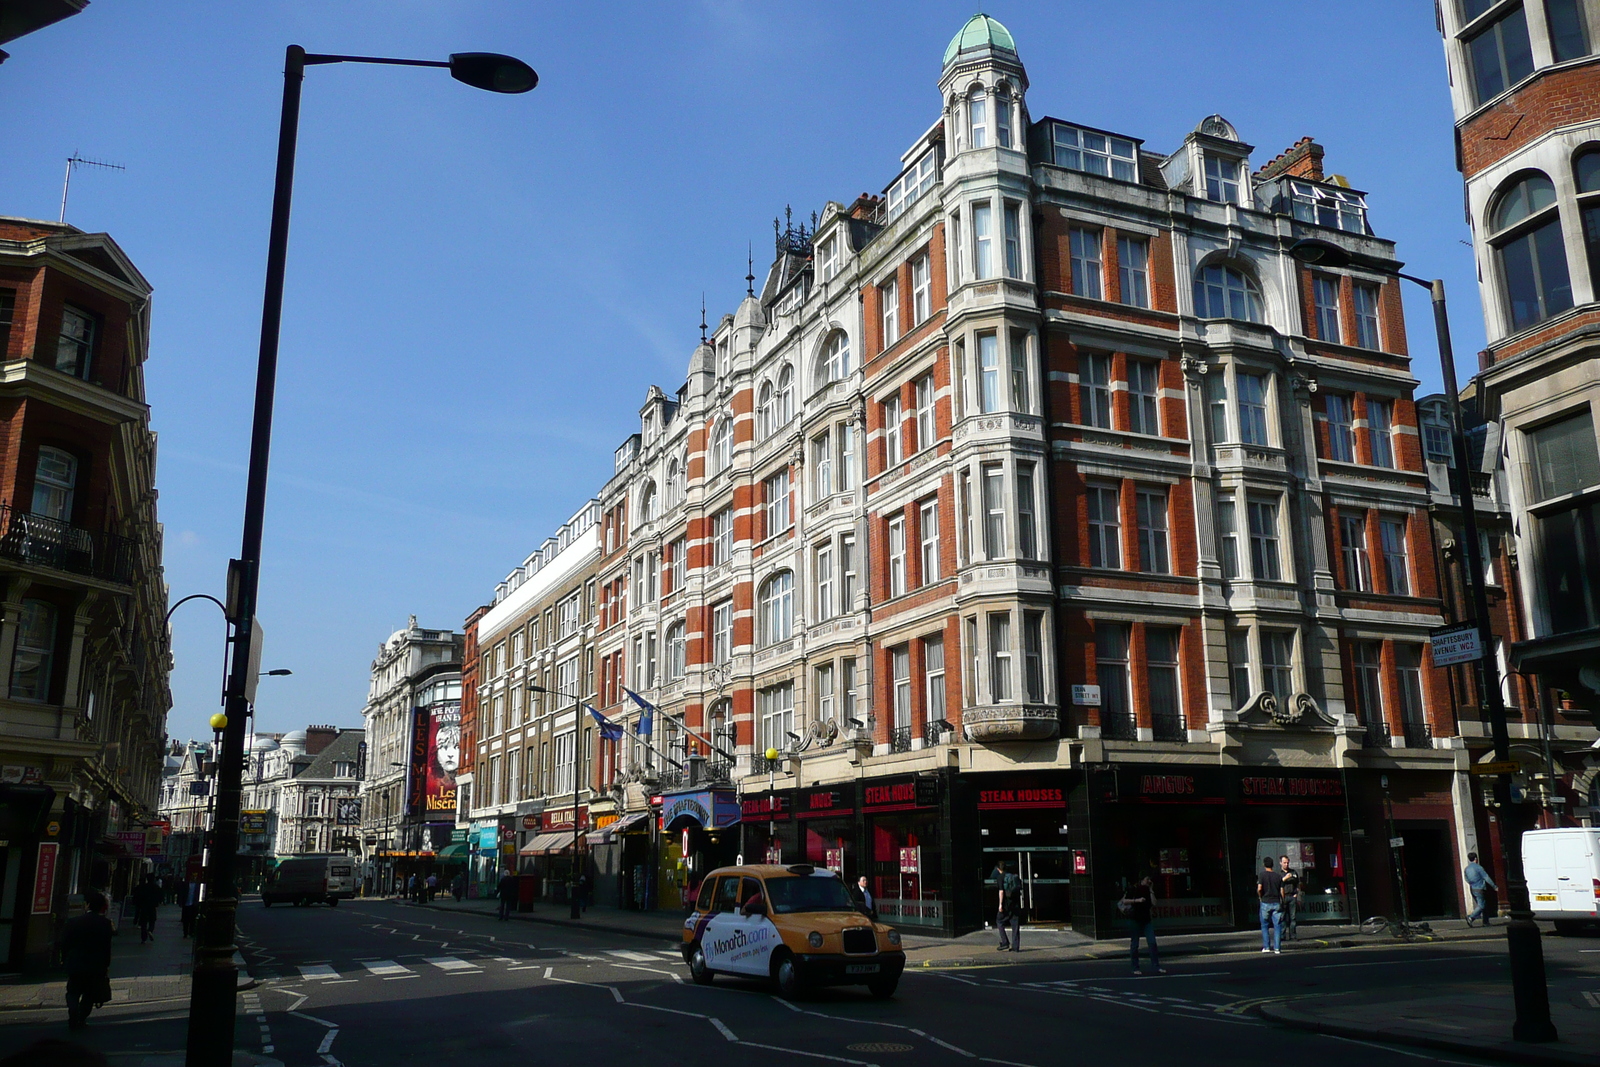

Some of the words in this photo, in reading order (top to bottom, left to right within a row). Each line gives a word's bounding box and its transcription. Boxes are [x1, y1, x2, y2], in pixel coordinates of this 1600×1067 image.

[1432, 632, 1473, 647] SHAFTESBURY
[1434, 645, 1457, 656] AVENUE
[1460, 642, 1475, 650] WC2
[414, 713, 427, 756] LES
[439, 786, 456, 799] Les
[1141, 775, 1194, 795] ANGUS
[1242, 777, 1286, 796] STEAK
[1289, 778, 1342, 797] HOUSES
[865, 785, 890, 804] STEAK
[980, 789, 1015, 803] STEAK
[1017, 788, 1063, 801] HOUSES
[550, 812, 563, 824] BELLA
[1152, 904, 1182, 919] STEAK
[1183, 904, 1222, 917] HOUSES
